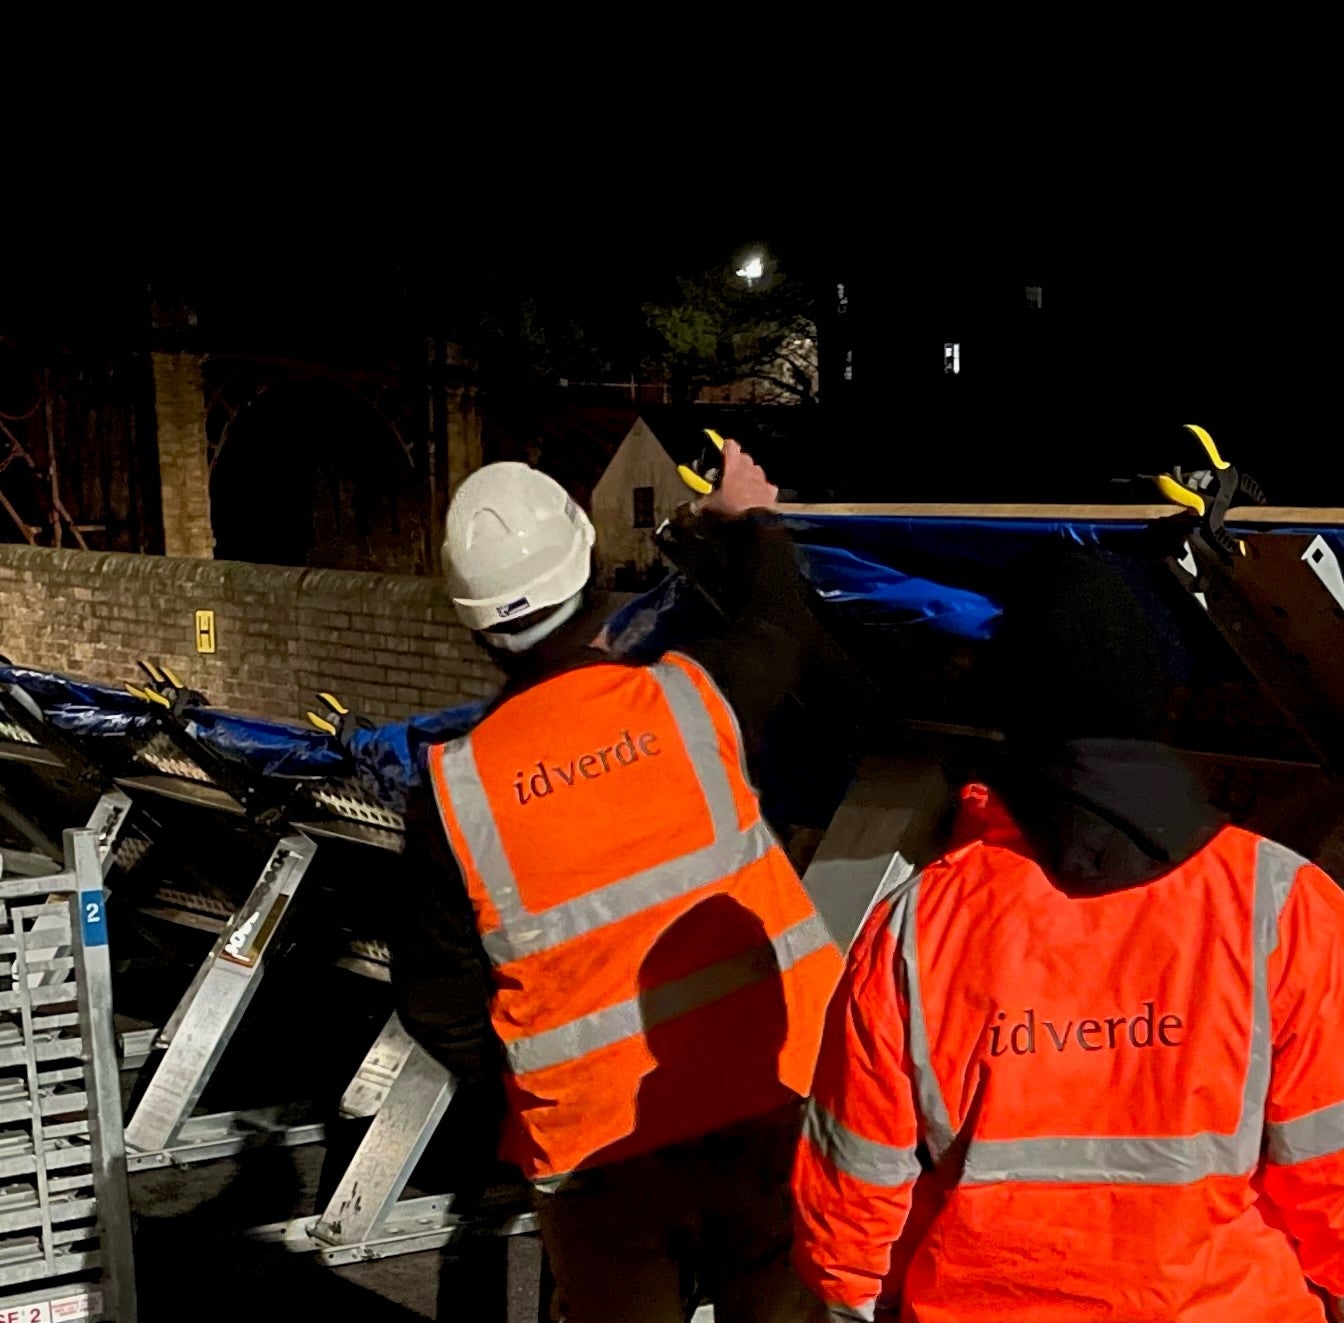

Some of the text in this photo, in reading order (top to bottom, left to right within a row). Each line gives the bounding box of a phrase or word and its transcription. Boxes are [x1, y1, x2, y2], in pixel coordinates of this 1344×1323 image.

[513, 729, 662, 805] idverde
[86, 903, 100, 922] 2
[989, 1001, 1183, 1057] idverde
[30, 1308, 42, 1323] 2
